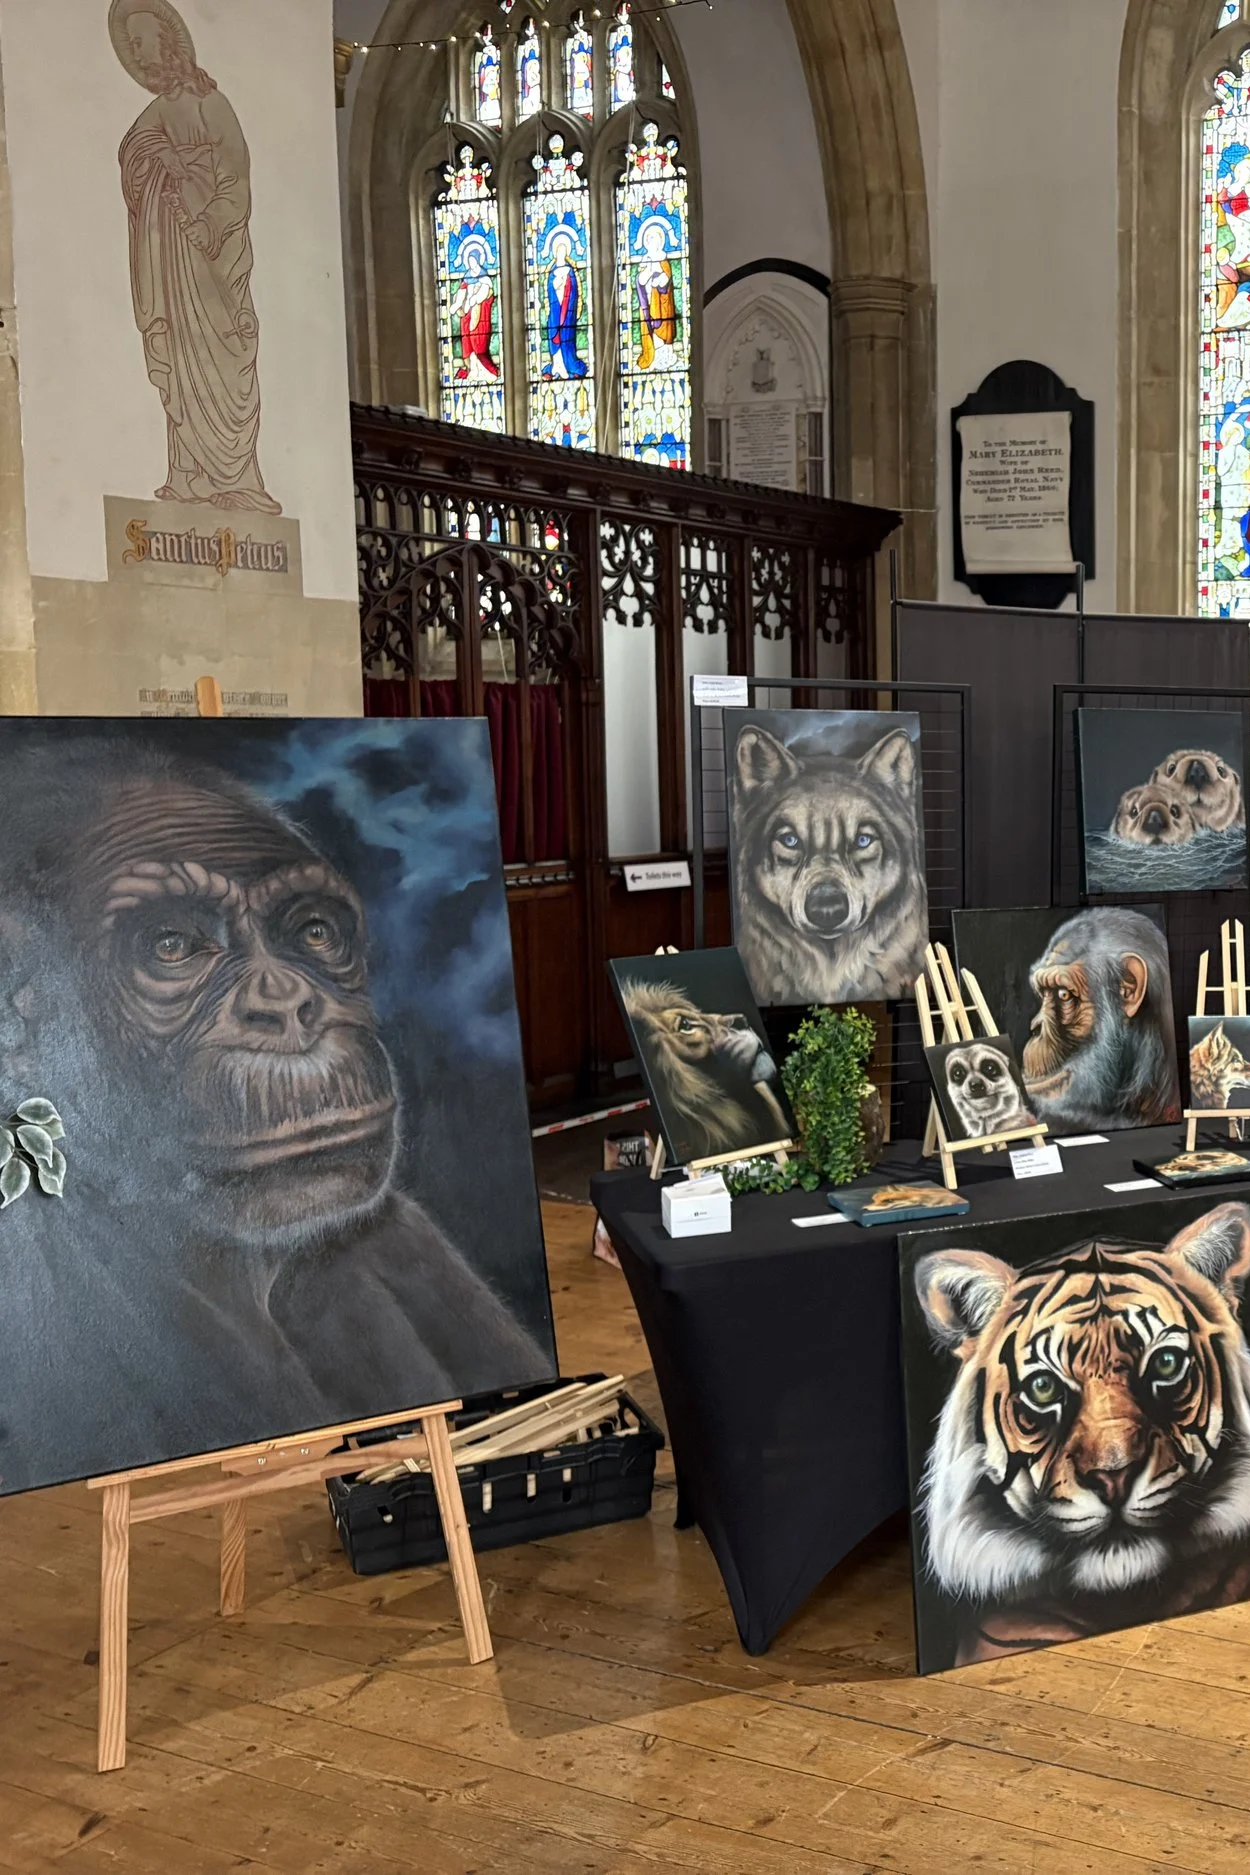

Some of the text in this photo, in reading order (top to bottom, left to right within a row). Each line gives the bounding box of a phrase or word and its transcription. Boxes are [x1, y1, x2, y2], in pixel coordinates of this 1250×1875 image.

[968, 450, 998, 460] MARY
[123, 519, 285, 577] Sanctus Petrus
